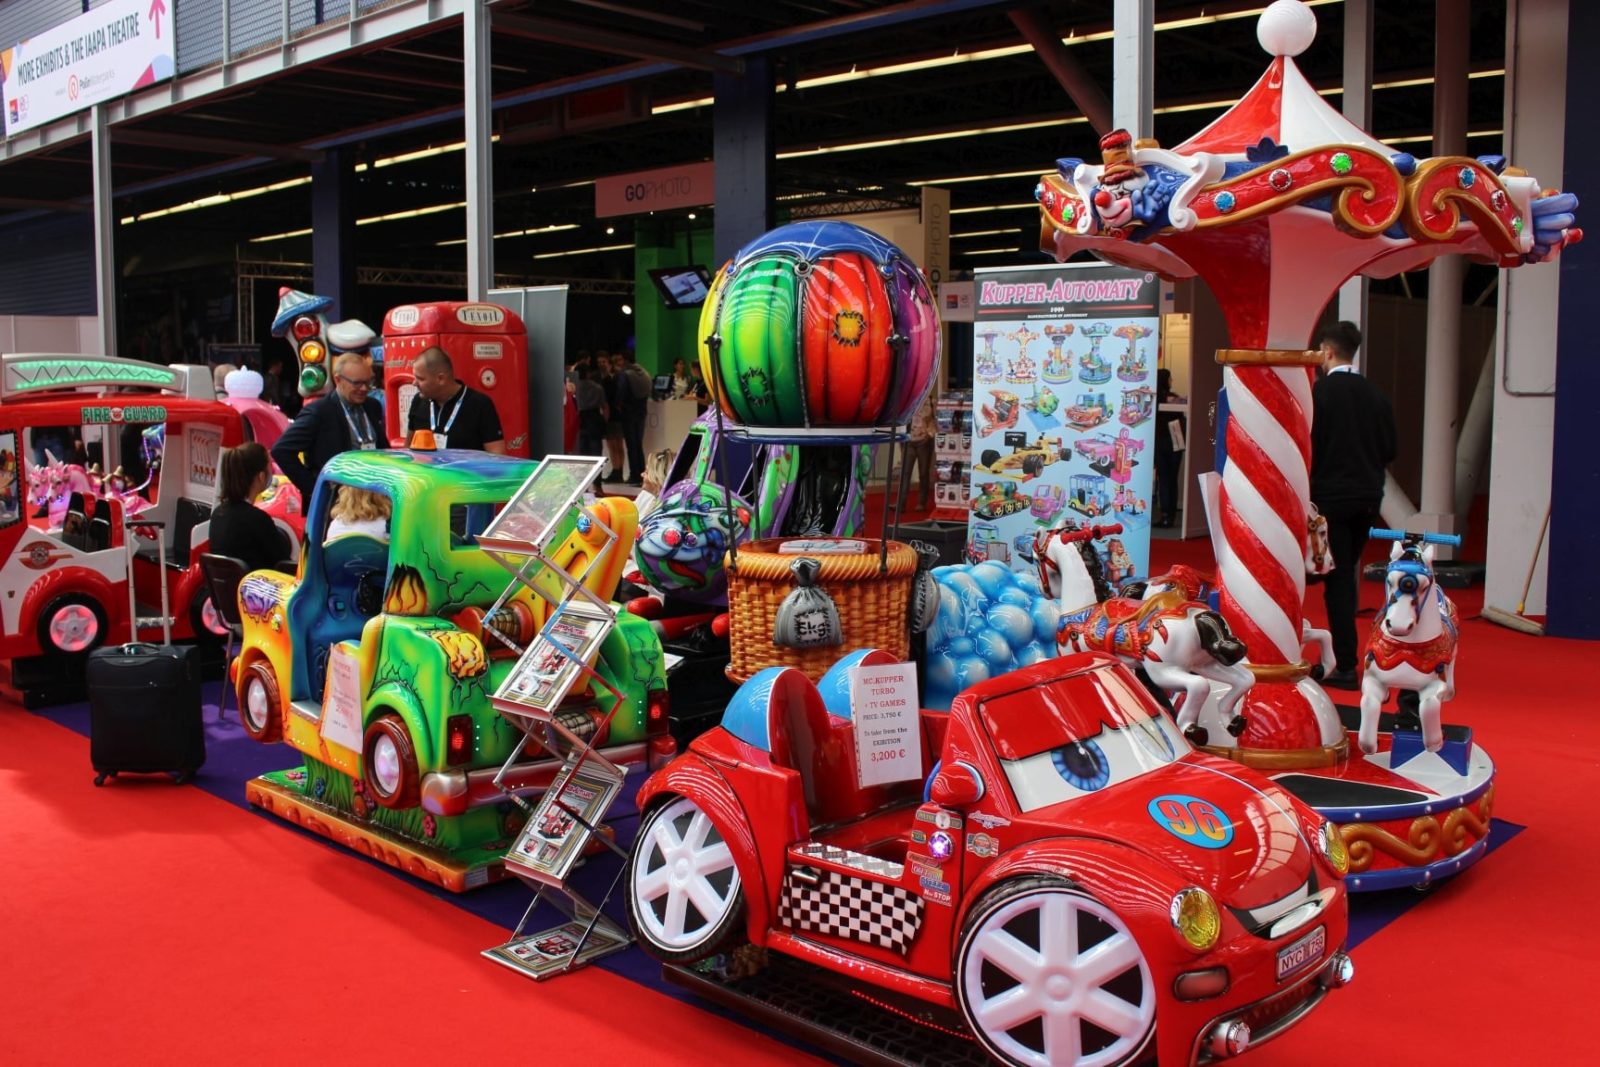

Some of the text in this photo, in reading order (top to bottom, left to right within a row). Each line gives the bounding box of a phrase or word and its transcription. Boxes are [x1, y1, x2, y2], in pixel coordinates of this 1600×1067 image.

[17, 12, 140, 87] MORE EXHIBITS & THE IAAPA THEATRE
[625, 177, 692, 202] GOPHOTO
[81, 405, 167, 424] FIRE GUARD
[872, 687, 896, 696] TURBO
[869, 701, 879, 709] TV
[880, 699, 906, 708] GAMES
[871, 749, 896, 763] 3,200
[1157, 799, 1227, 842] 96
[1281, 950, 1303, 972] NYC
